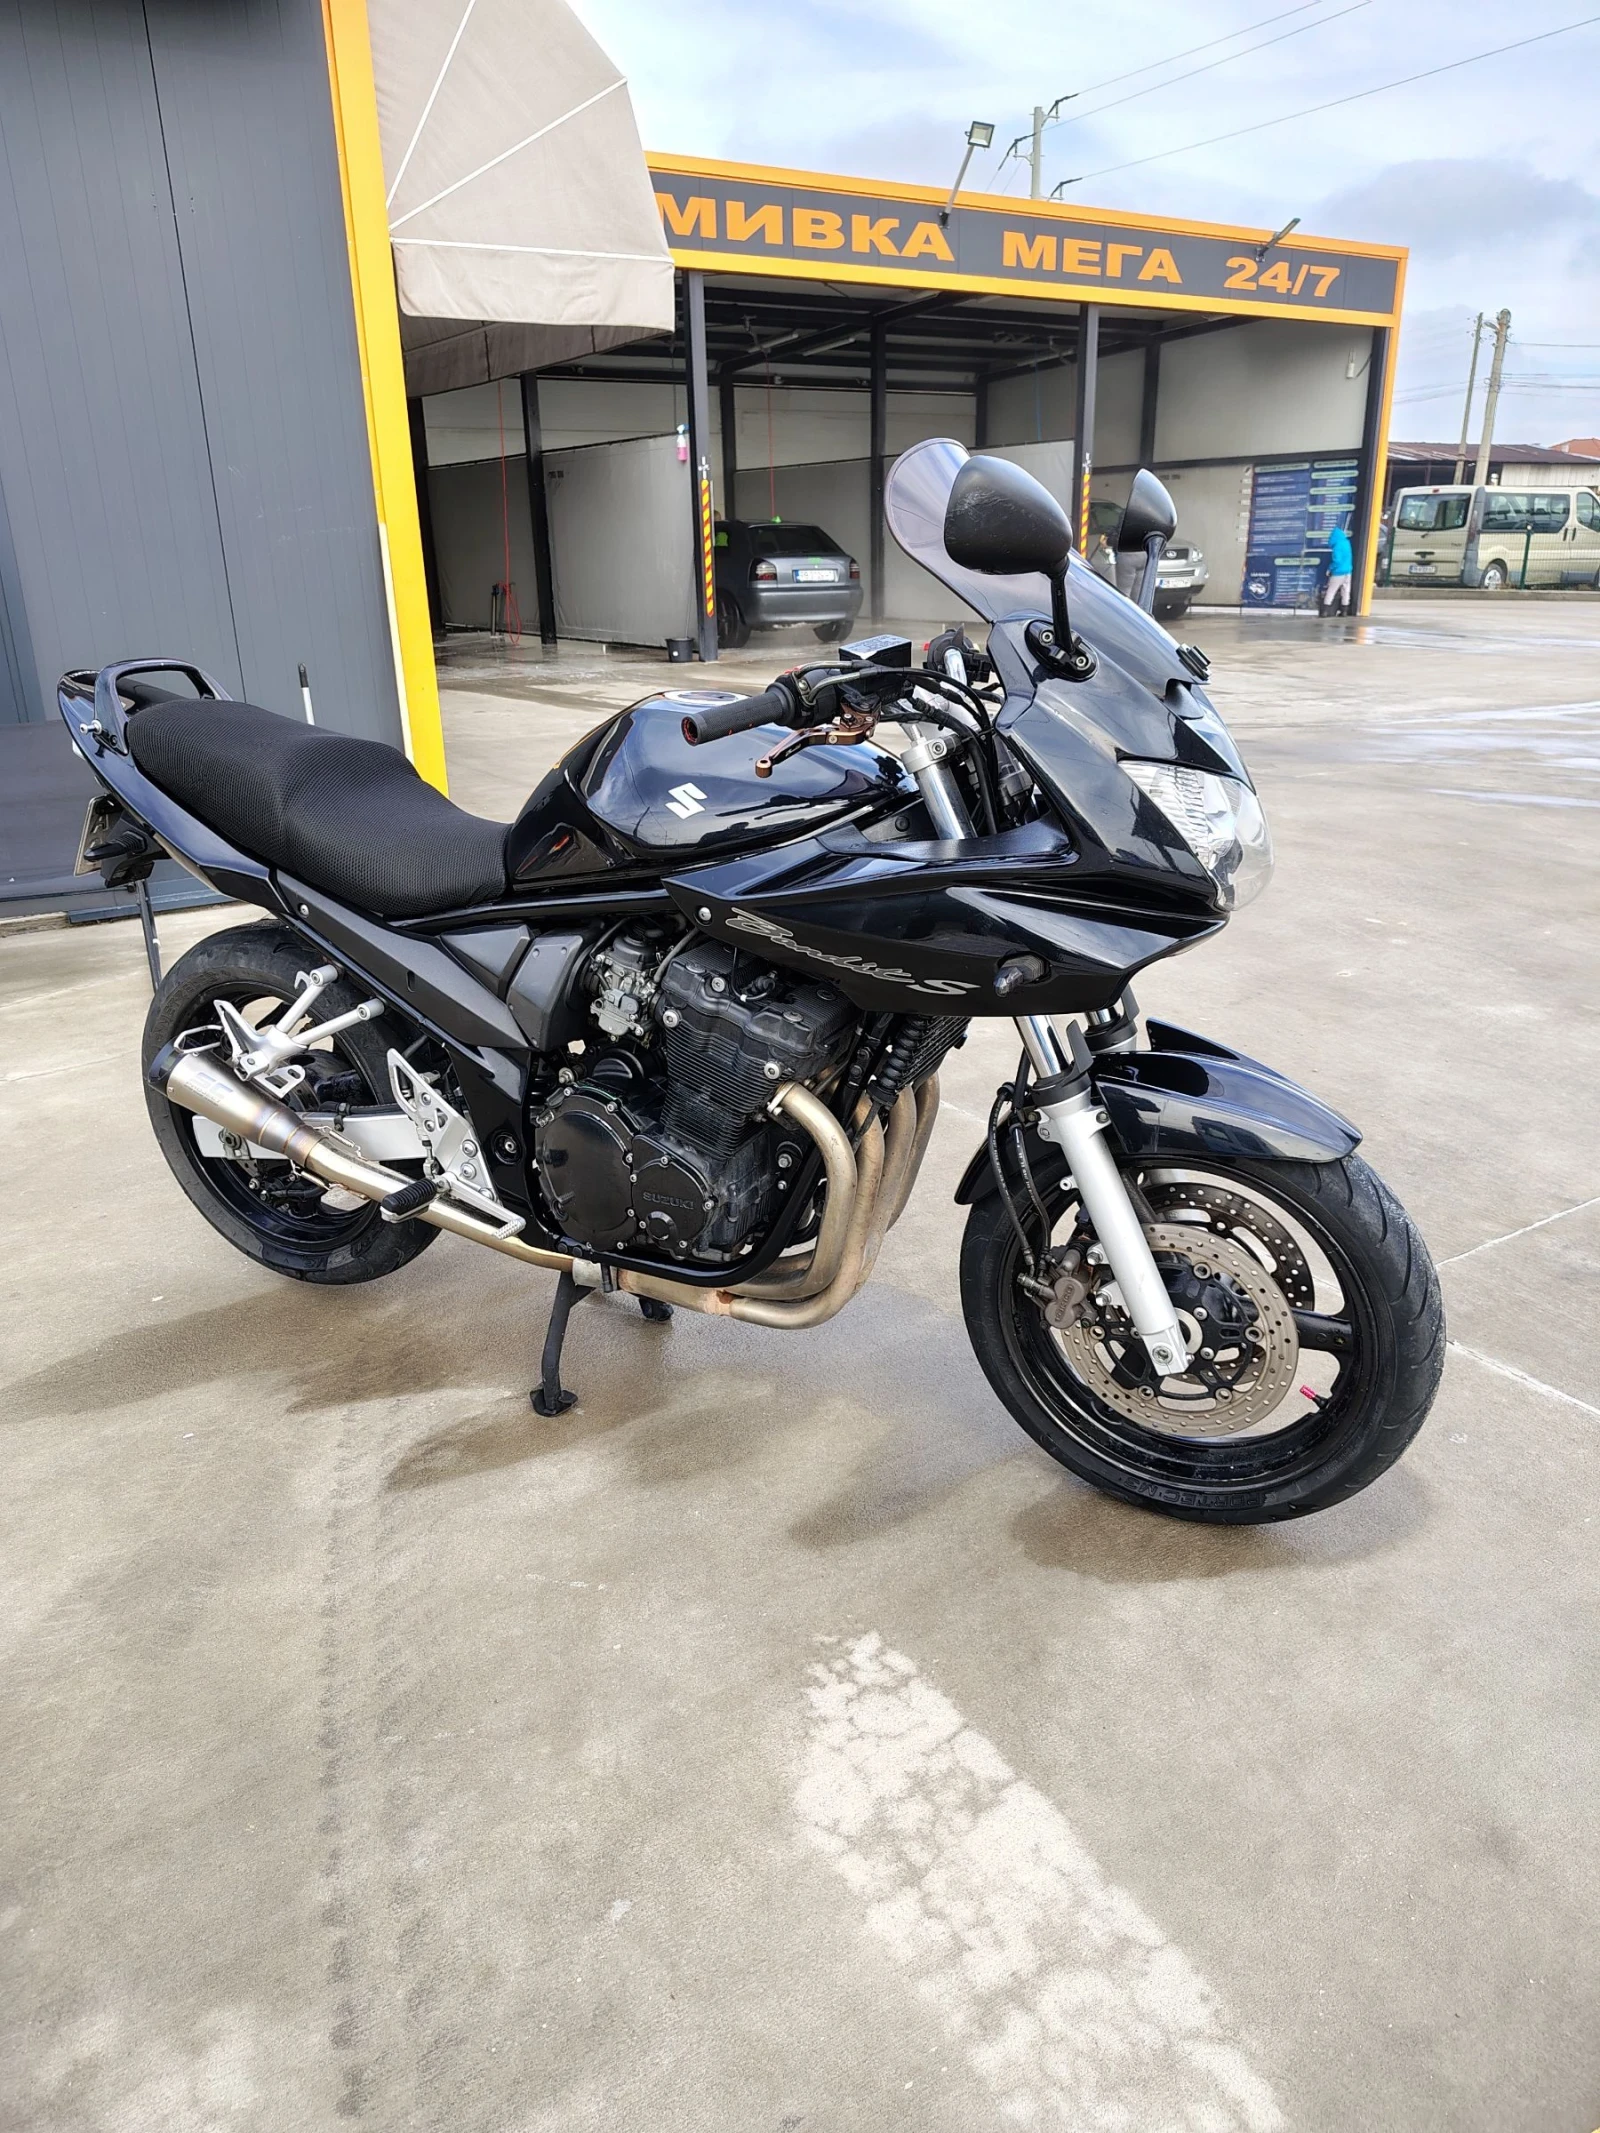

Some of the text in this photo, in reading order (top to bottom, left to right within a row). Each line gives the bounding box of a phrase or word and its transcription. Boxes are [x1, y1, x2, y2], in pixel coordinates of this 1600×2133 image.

[653, 192, 1341, 297] МИВКА МЕГА 24/7
[726, 907, 981, 995] Bandit S
[642, 1191, 694, 1210] SUZUKI
